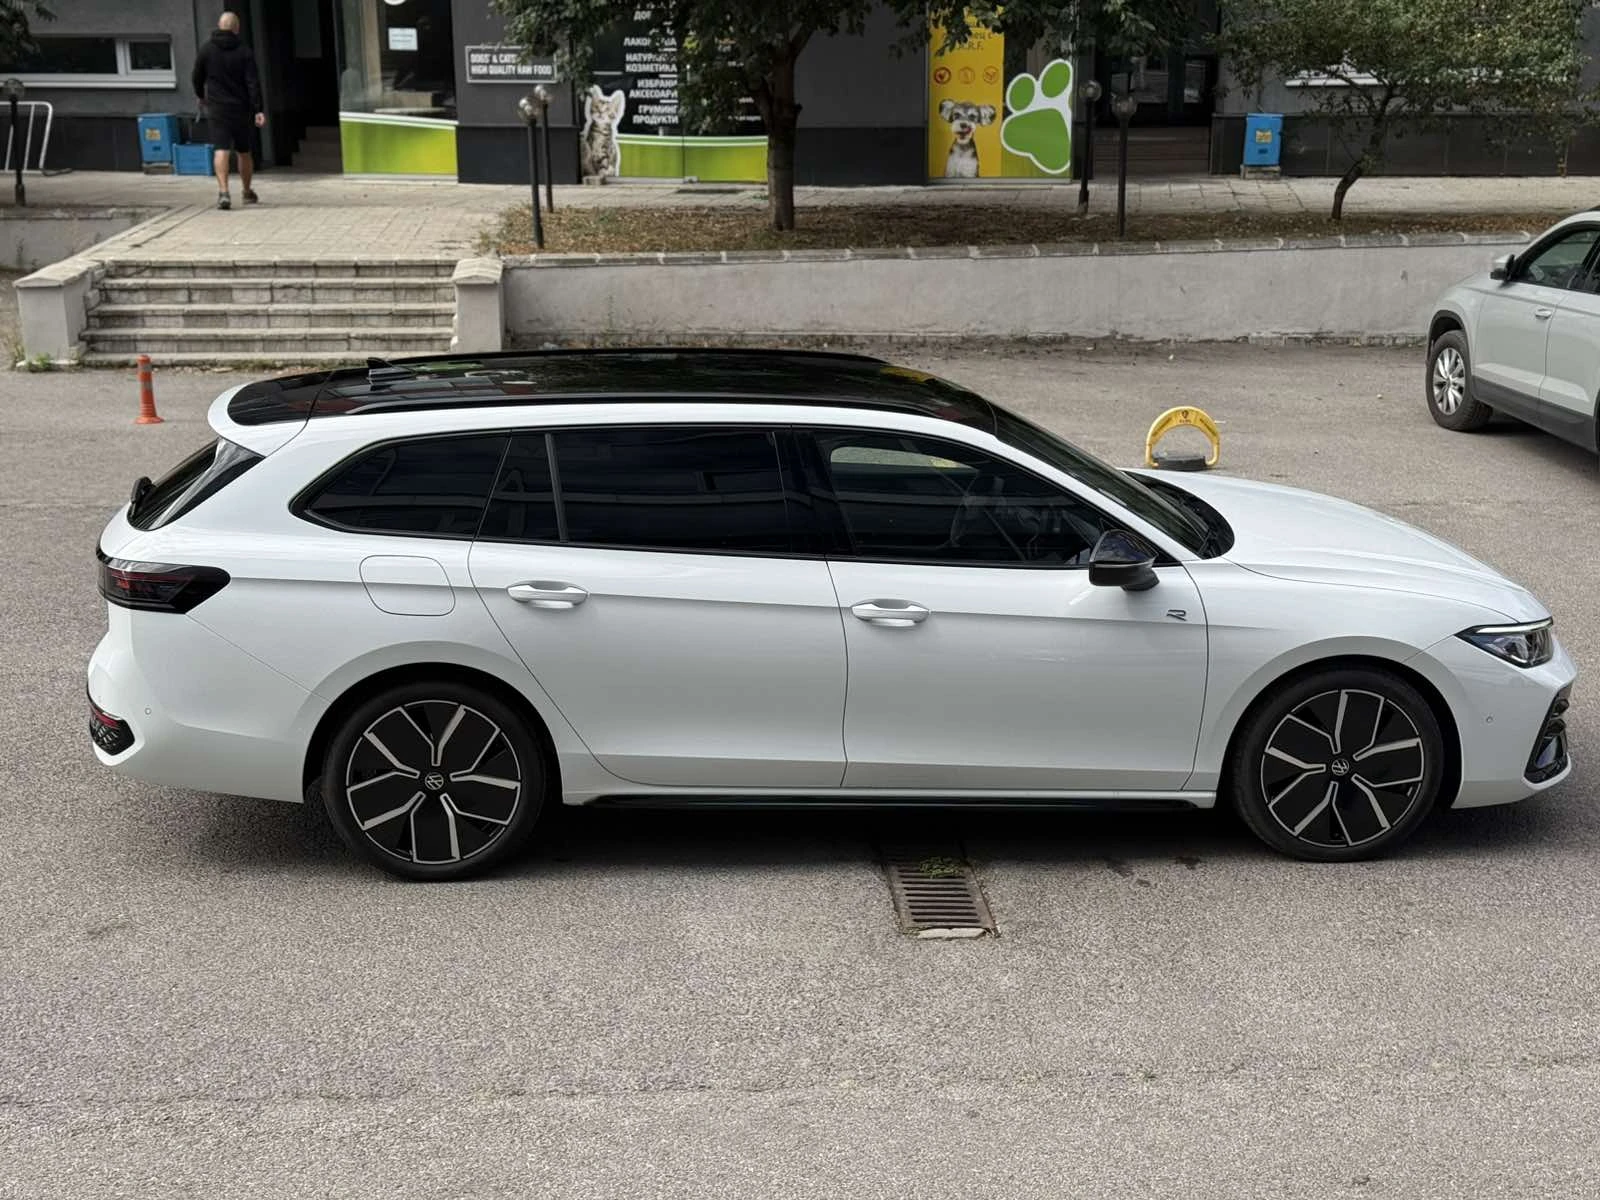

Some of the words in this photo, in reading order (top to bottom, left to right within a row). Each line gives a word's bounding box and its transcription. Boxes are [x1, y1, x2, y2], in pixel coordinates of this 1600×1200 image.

[471, 64, 488, 75] HIGH
[489, 64, 516, 75] QUALITY
[533, 64, 552, 75] FOOD
[625, 63, 678, 73] КОЗМЕТИКА
[629, 89, 678, 98] АКСЕСОАРИ
[638, 105, 678, 114] ГРУМИНГ
[632, 115, 679, 125] ПРОДУКТИ
